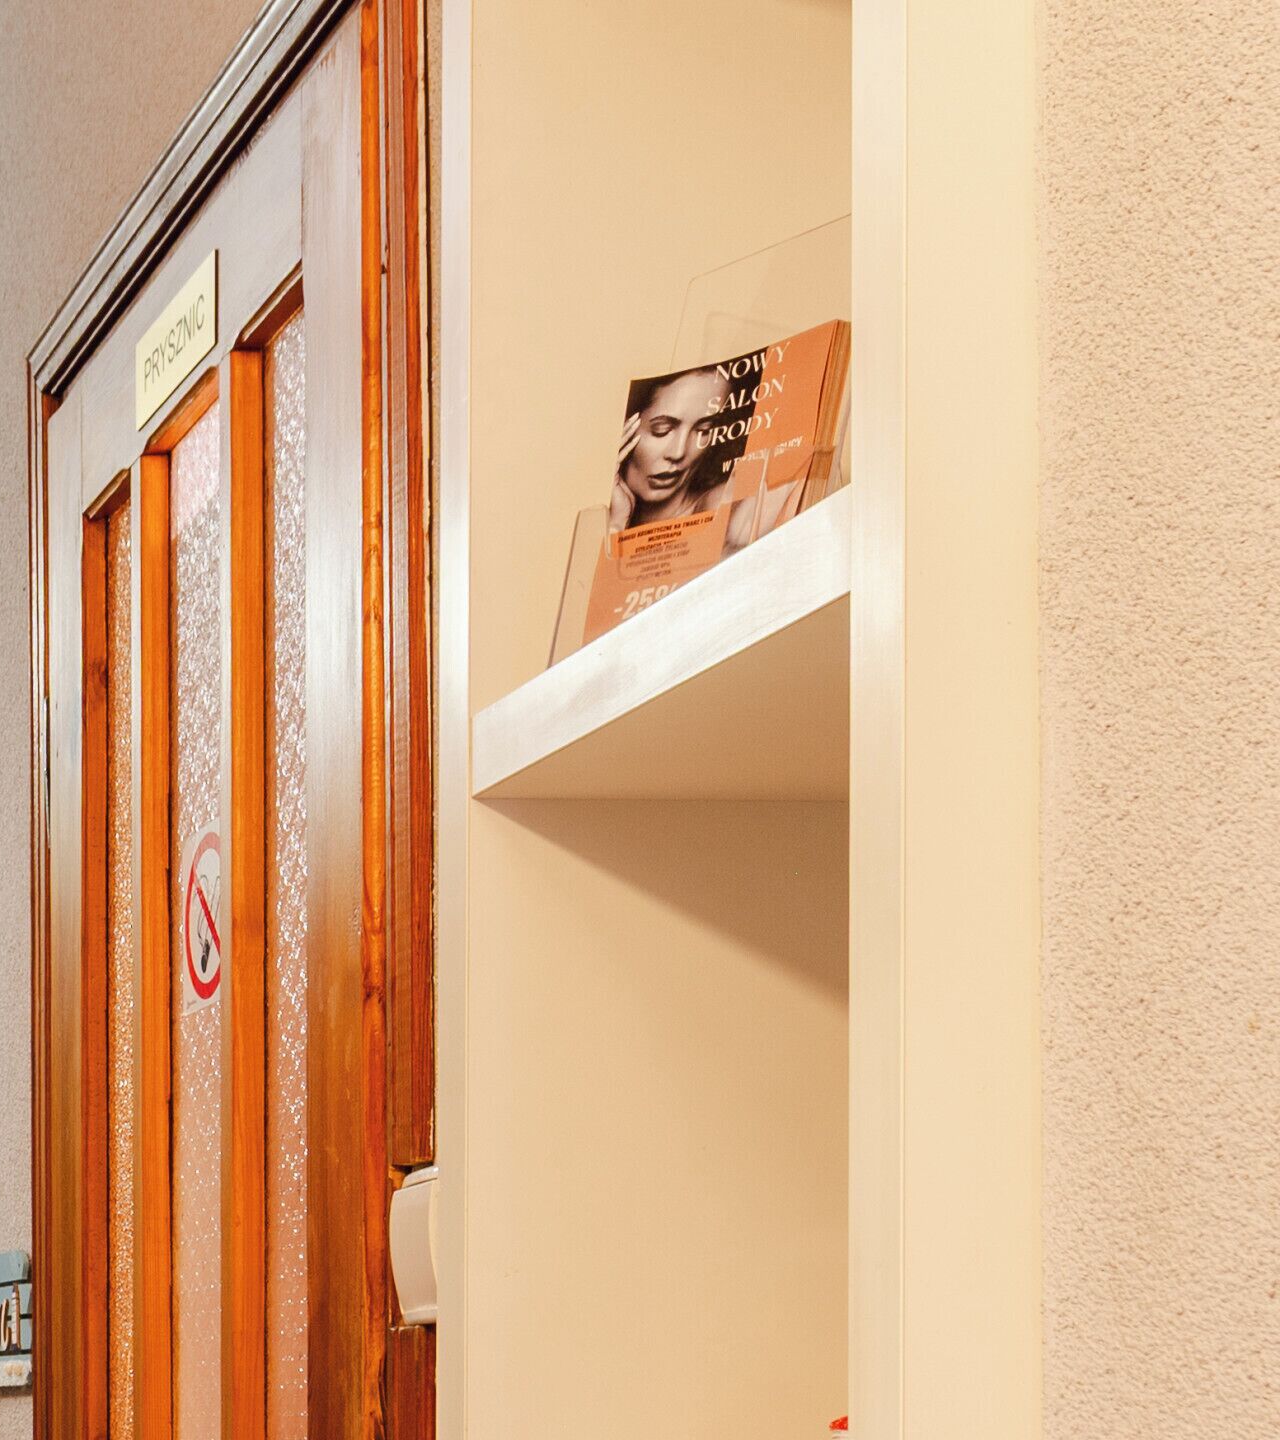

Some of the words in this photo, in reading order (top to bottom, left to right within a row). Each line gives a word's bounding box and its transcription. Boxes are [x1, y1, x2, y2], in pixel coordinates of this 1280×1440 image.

[143, 293, 206, 393] PRYSZNIC
[713, 341, 791, 384] NOWY
[705, 374, 786, 416] SALON
[695, 407, 779, 450] URODY
